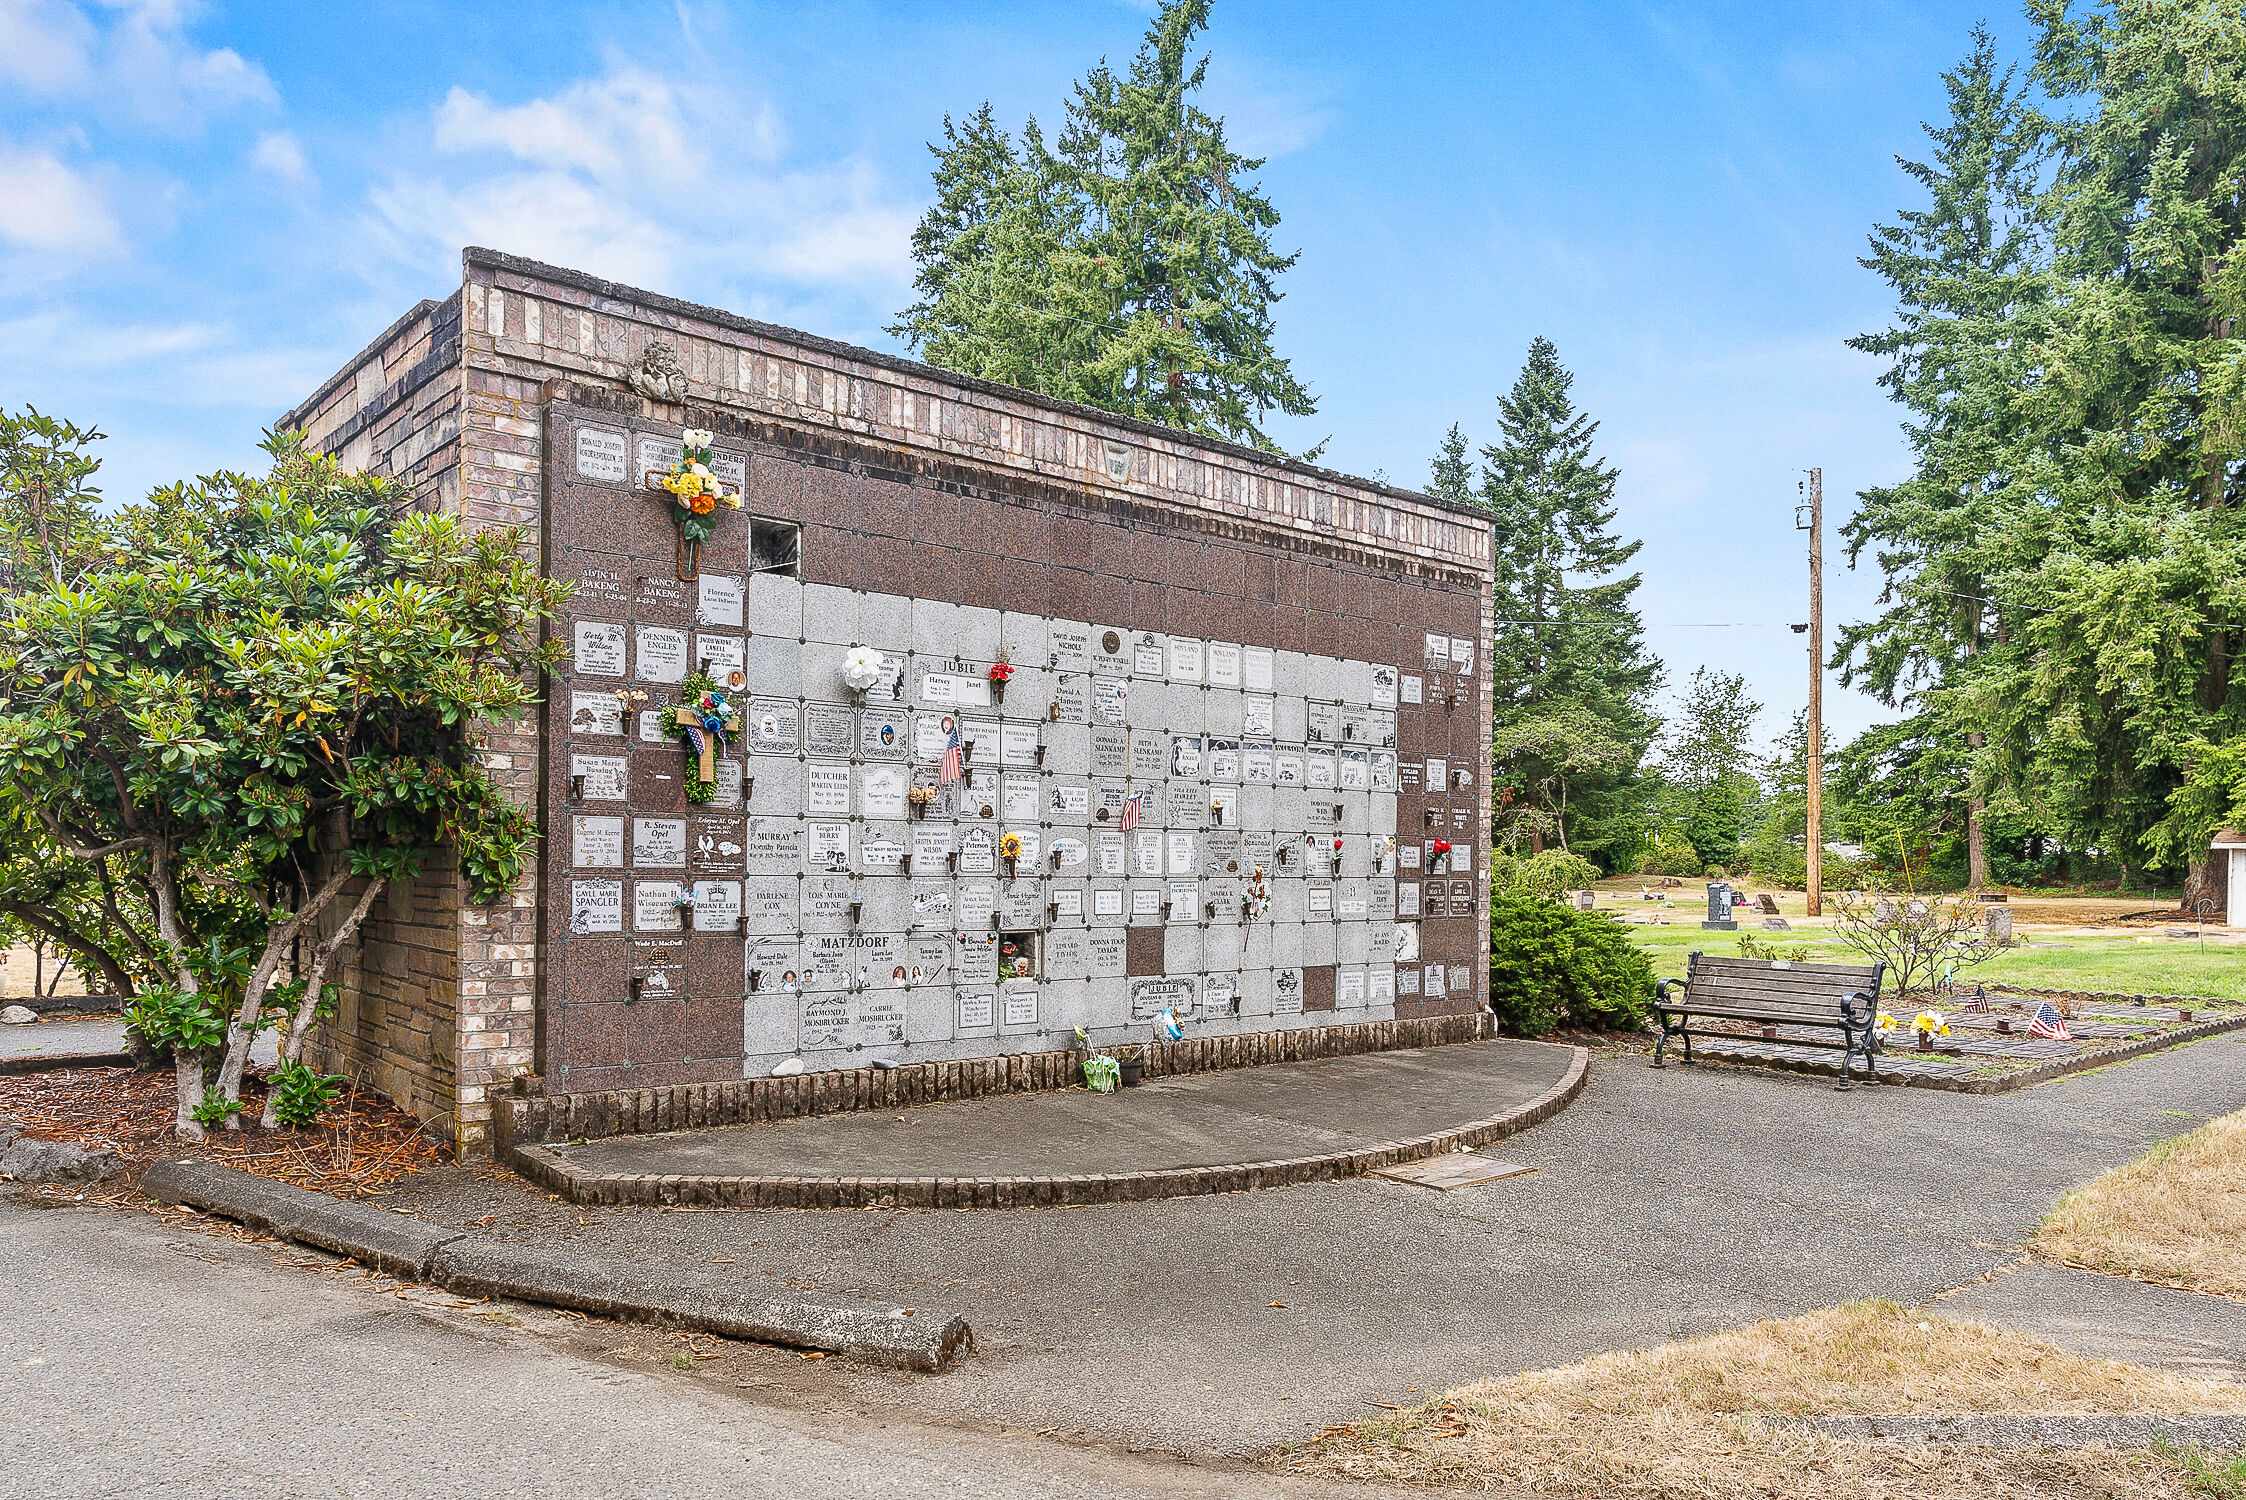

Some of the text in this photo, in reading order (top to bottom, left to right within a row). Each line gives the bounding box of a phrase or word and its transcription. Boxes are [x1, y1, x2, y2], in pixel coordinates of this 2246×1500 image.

[582, 580, 619, 591] BAKENG
[649, 577, 675, 588] NANCY
[644, 587, 680, 599] BAKENG
[708, 589, 734, 597] Florence
[643, 632, 681, 643] DENNISSA
[647, 641, 676, 650] ENGLES
[1059, 642, 1081, 650] NICHOLS
[943, 660, 976, 674] JUBIE
[929, 677, 981, 689] Harvey Janet
[1057, 687, 1073, 695] David
[811, 772, 848, 781] DUTCHER
[651, 830, 668, 839] Opel
[576, 898, 618, 906] SPANGLER
[821, 936, 890, 949] MATZDORF
